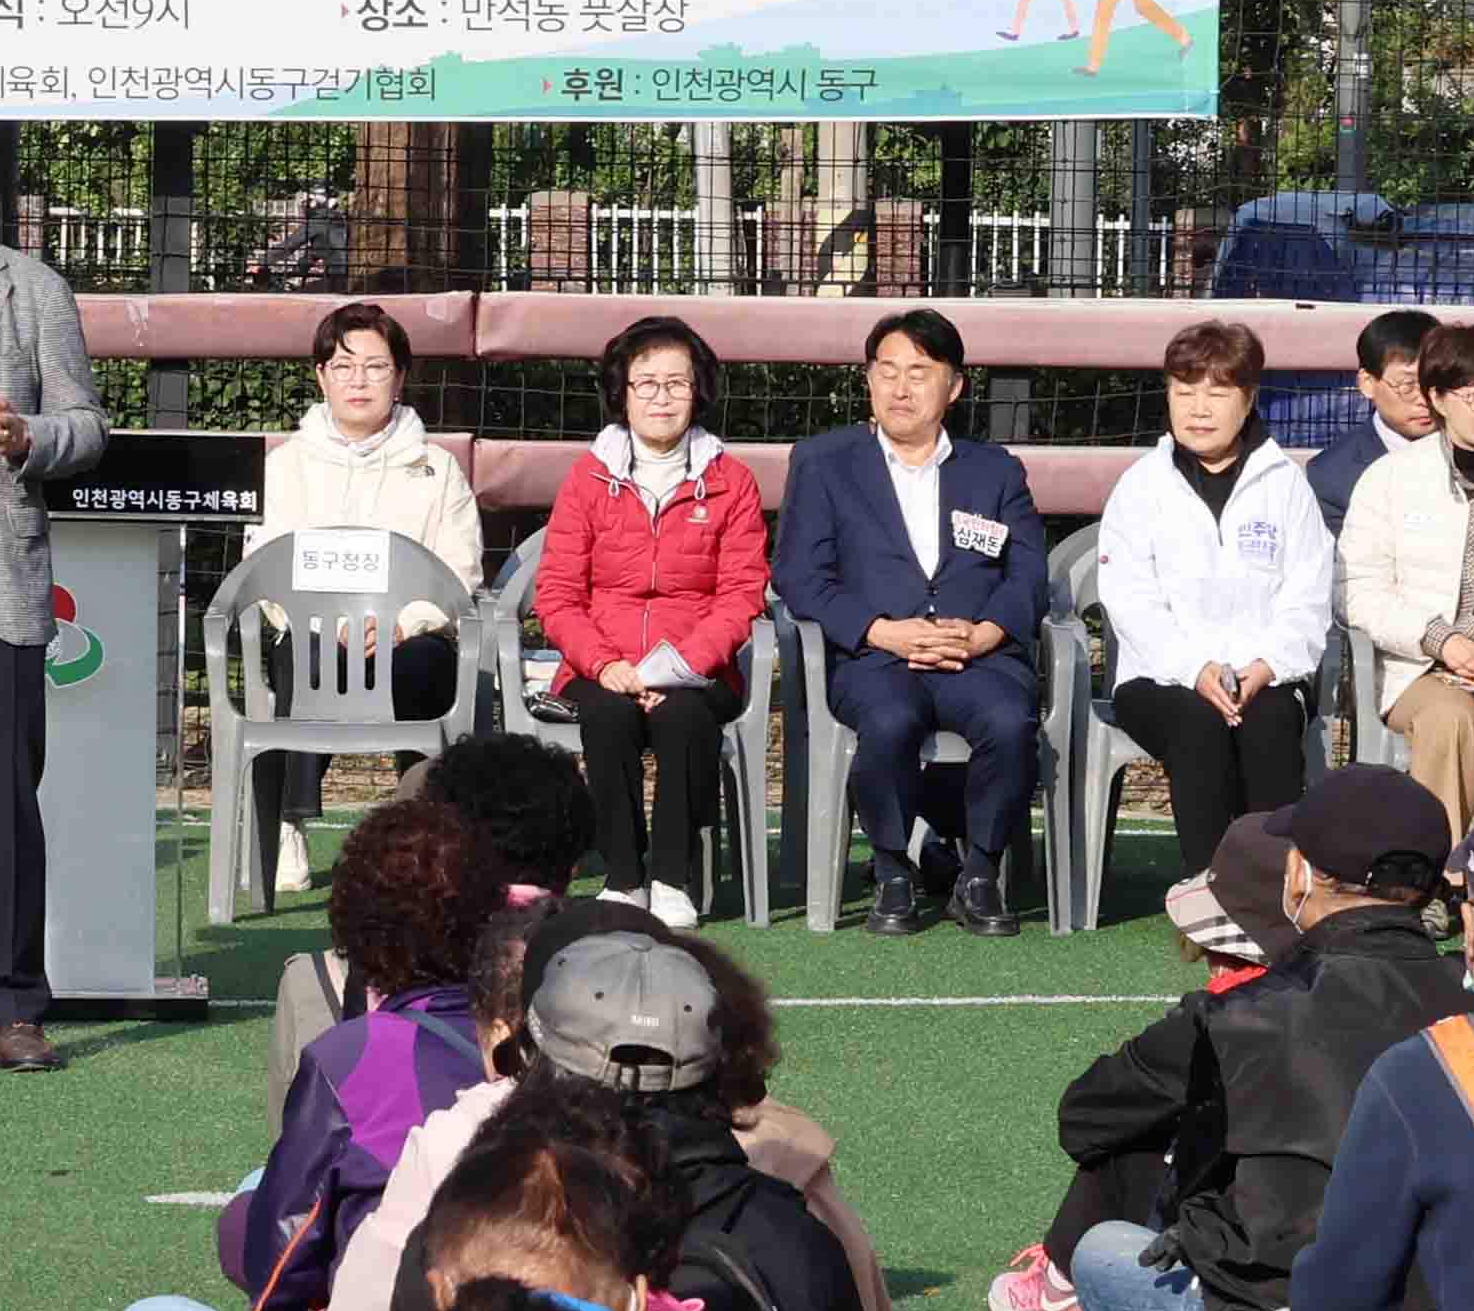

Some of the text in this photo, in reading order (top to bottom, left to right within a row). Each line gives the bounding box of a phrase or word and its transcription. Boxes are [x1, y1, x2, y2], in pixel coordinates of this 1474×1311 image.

[88, 64, 436, 102] 인천광역시동구걷기협회
[560, 67, 624, 102] 후원
[651, 67, 808, 103] 인천광역시
[815, 68, 880, 103] 동구
[72, 488, 258, 512] 인천광역시동구체육회
[956, 527, 999, 555] 심재돈
[302, 549, 380, 572] 동구청장
